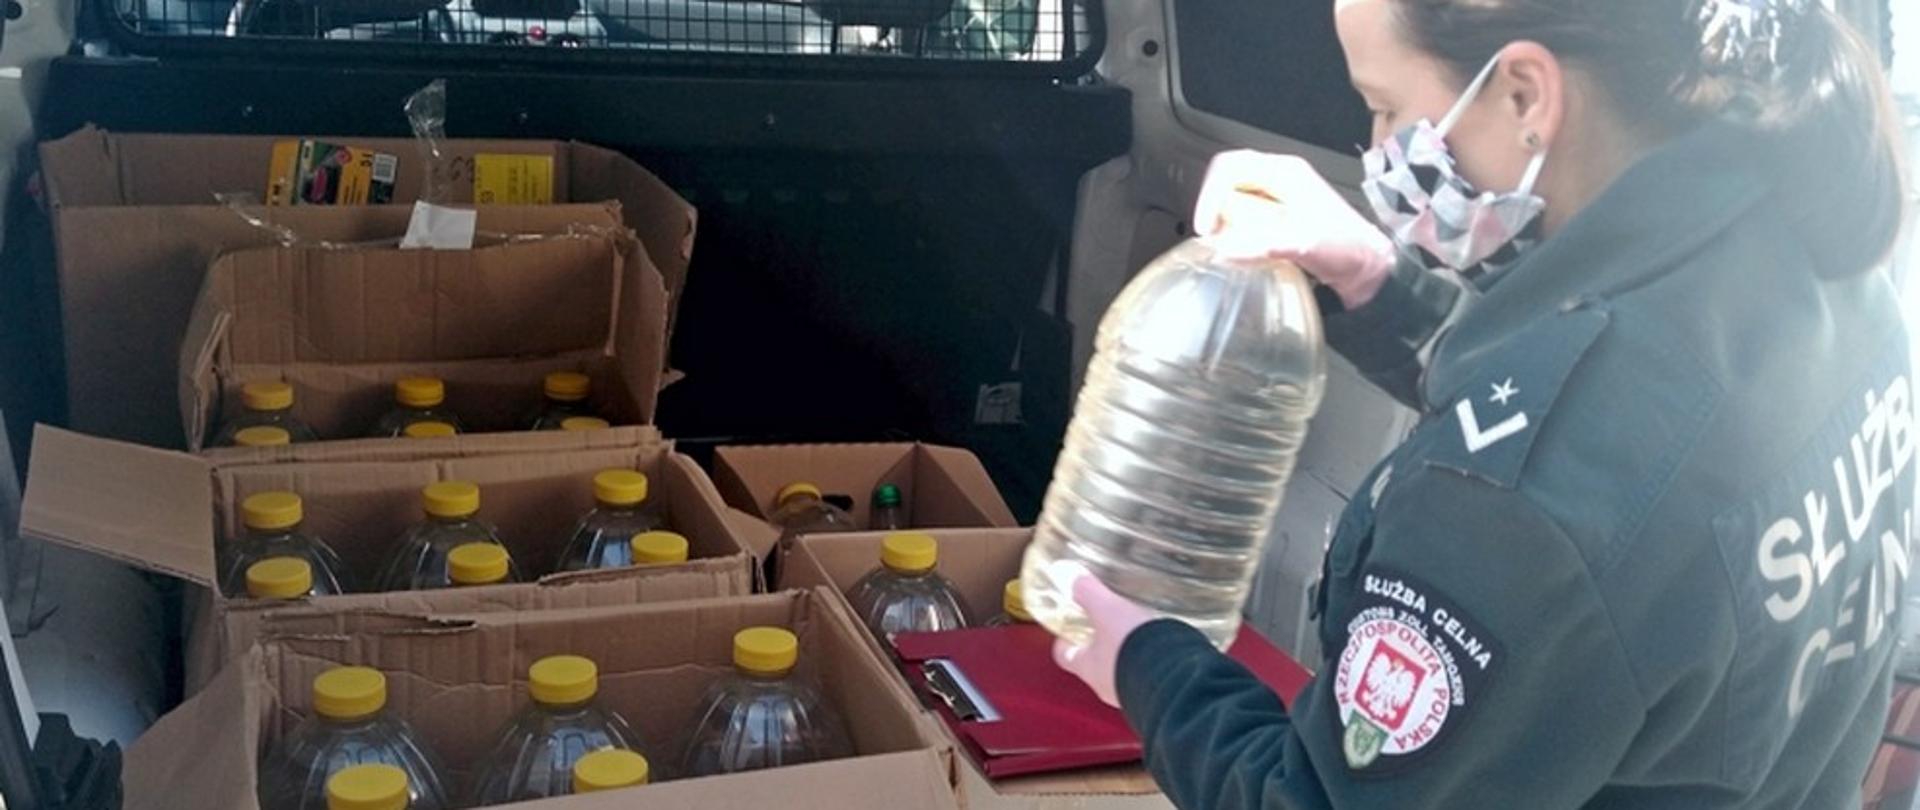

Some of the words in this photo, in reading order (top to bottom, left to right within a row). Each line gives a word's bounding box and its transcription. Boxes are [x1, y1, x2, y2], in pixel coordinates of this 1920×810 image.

[1364, 574, 1426, 613] SŁUŻBA
[1432, 608, 1492, 670] CELNA
[1398, 610, 1430, 638] ZOLL
[1337, 620, 1442, 705] RZECZPOSPOLITA
[1394, 685, 1449, 750] POLSKA
